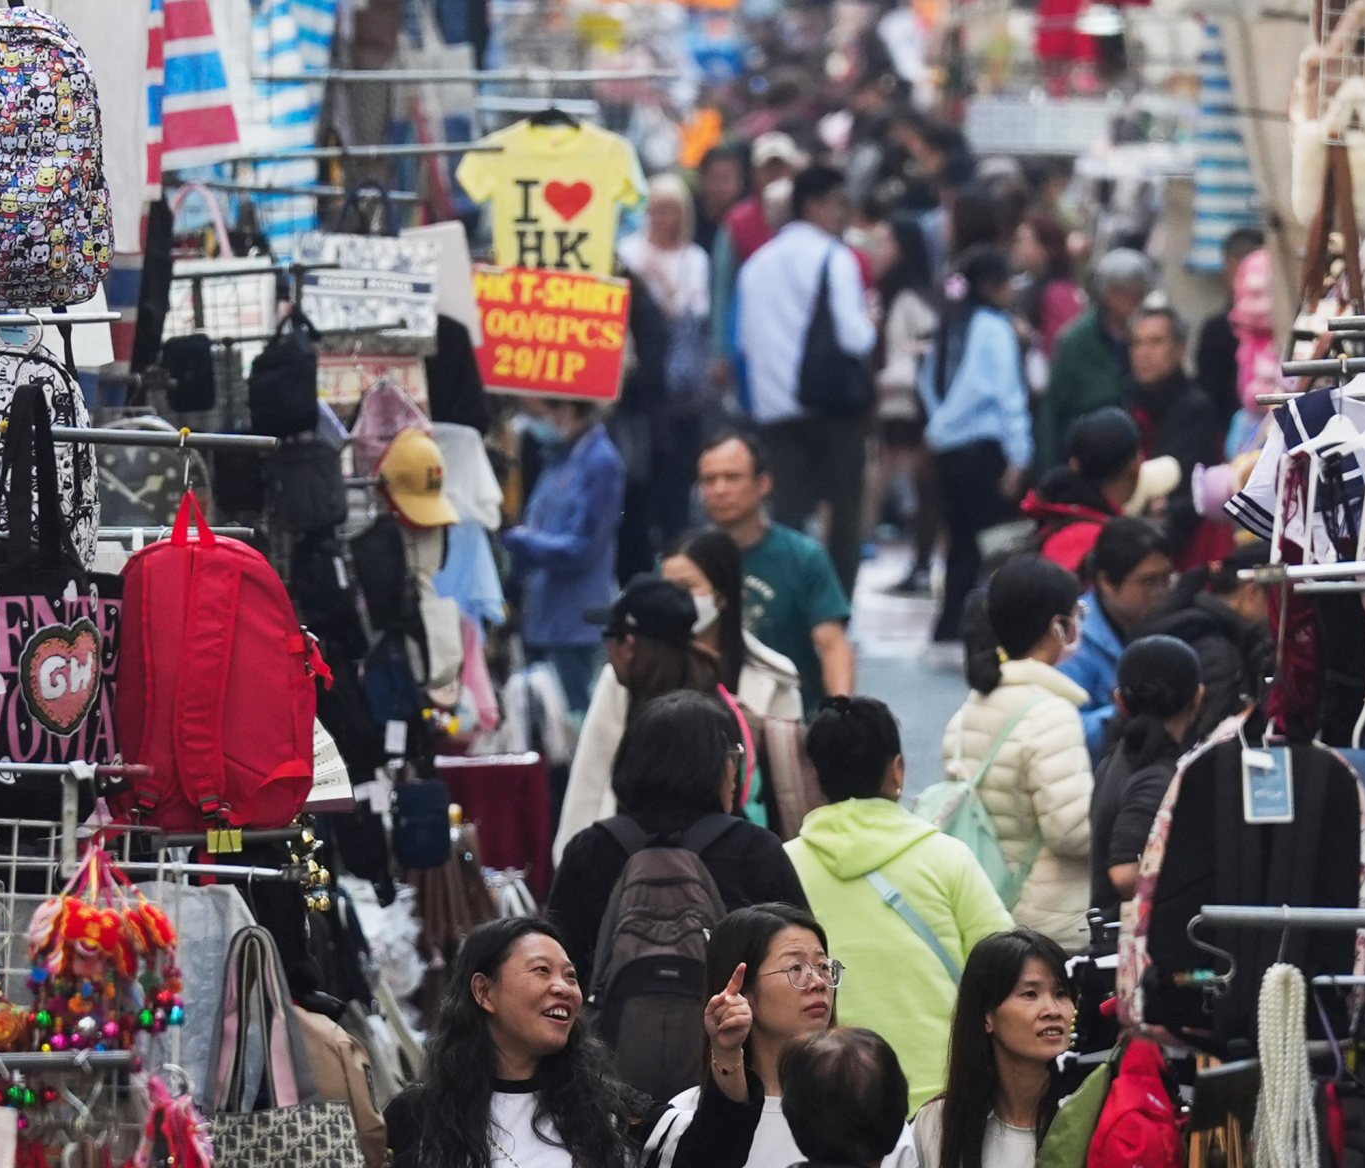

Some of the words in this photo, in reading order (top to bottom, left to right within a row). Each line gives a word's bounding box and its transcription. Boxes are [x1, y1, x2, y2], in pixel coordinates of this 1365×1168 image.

[514, 178, 540, 225] I
[515, 231, 591, 271] HK
[518, 275, 627, 316] T-SHIRT
[480, 308, 625, 350] 00/6PCS
[492, 343, 586, 385] 29/1P
